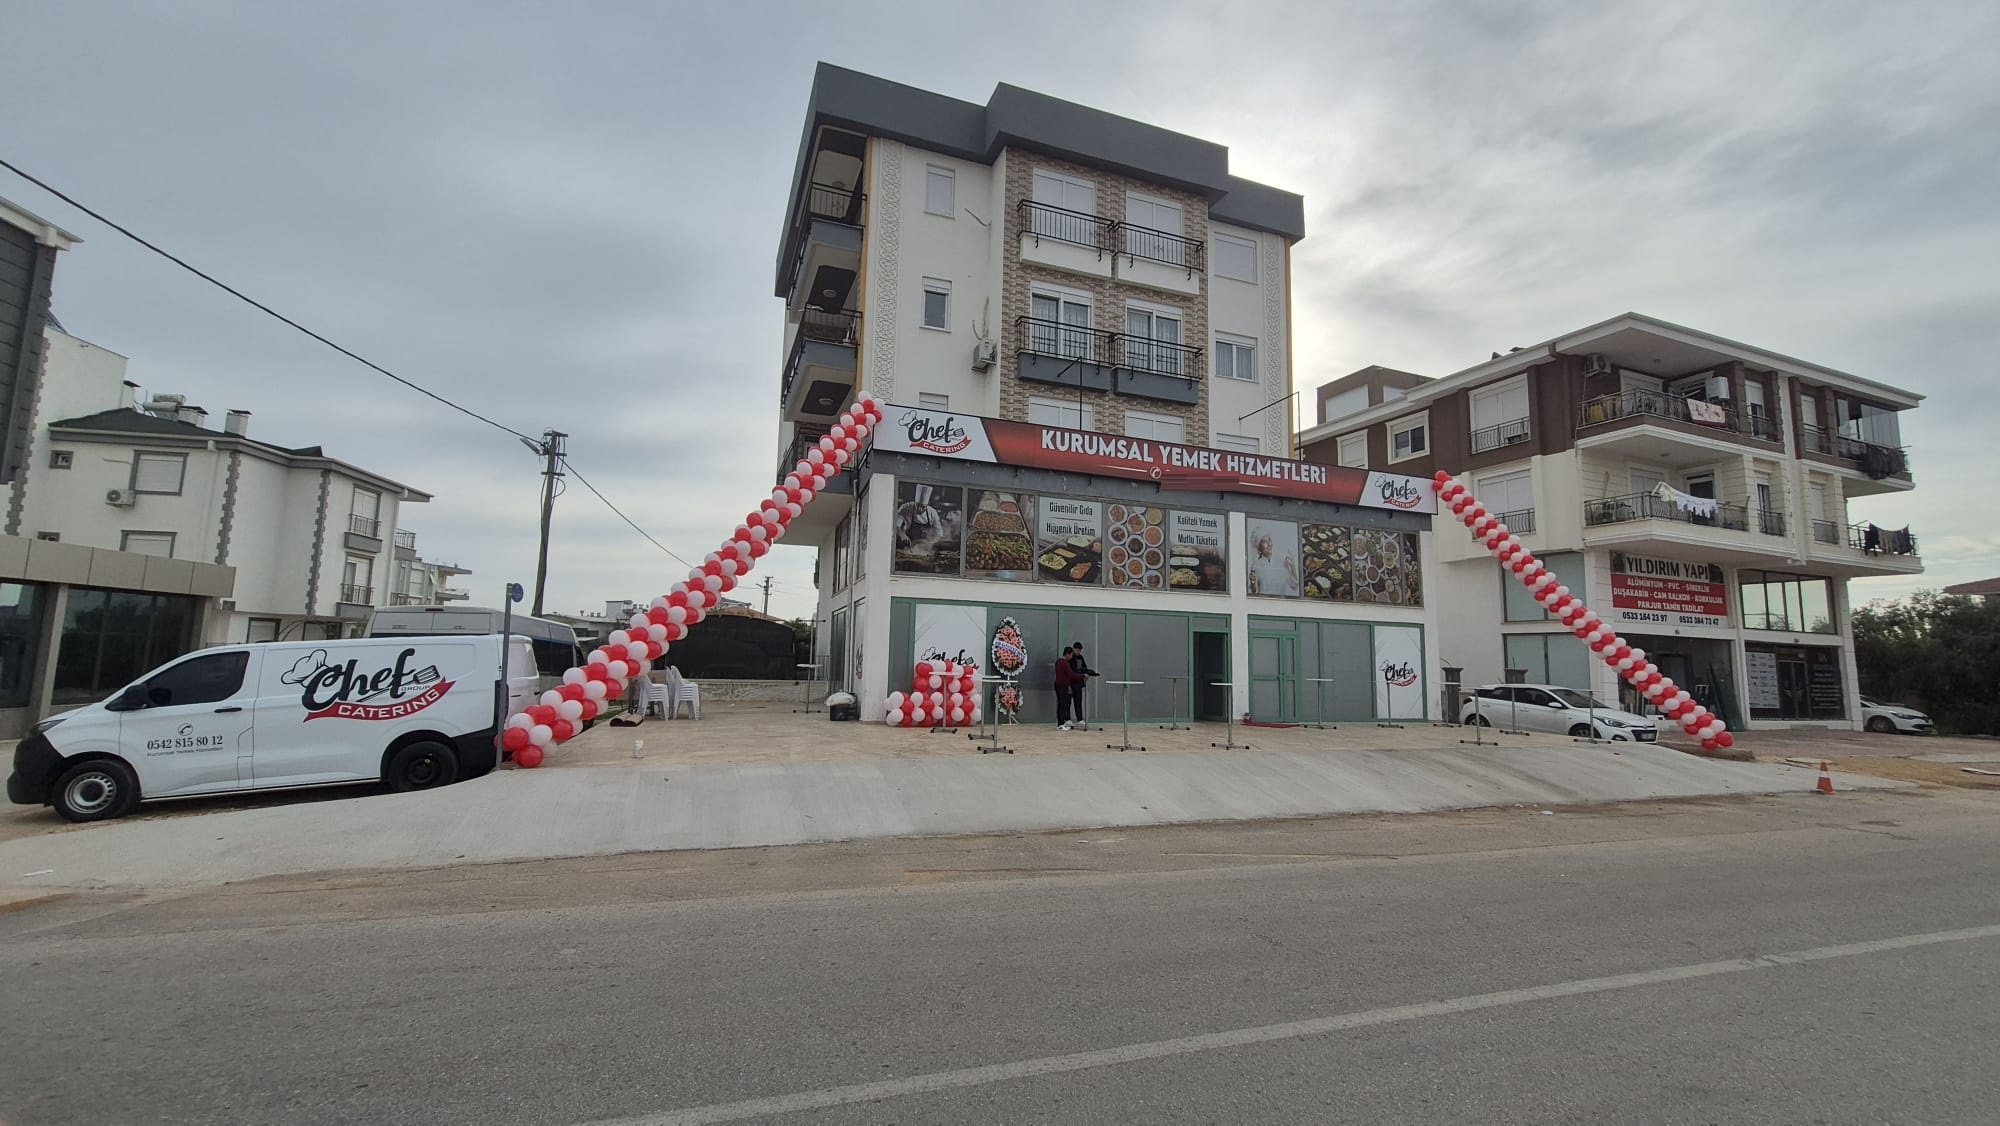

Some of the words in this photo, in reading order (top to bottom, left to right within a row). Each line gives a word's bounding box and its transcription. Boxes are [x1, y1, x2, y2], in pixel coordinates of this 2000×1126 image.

[908, 417, 953, 443] Chef
[923, 442, 965, 453] CATERING
[1041, 429, 1154, 463] KURUMSAL
[1159, 445, 1222, 471] YEMEK
[1382, 479, 1410, 500] Chef
[1049, 502, 1077, 514] Güvenilir
[1080, 505, 1093, 515] Gıda
[1046, 522, 1072, 535] Hijyenik
[1073, 523, 1095, 536] Üretim
[1177, 516, 1198, 526] Kaliteli
[1199, 518, 1218, 528] Yemek
[1178, 534, 1194, 544] Mutlu
[1196, 535, 1218, 546] Tüketici
[1627, 557, 1680, 577] YILDIRIM
[1683, 563, 1709, 580] YAPI
[1668, 582, 1680, 590] PVC
[1653, 591, 1667, 599] CAM
[1622, 611, 1638, 620] 0533
[302, 648, 416, 711] Chef
[338, 688, 440, 718] CATERING
[147, 739, 172, 750] 0542
[175, 737, 193, 749] 815
[196, 736, 208, 746] 80
[212, 735, 223, 745] 12
